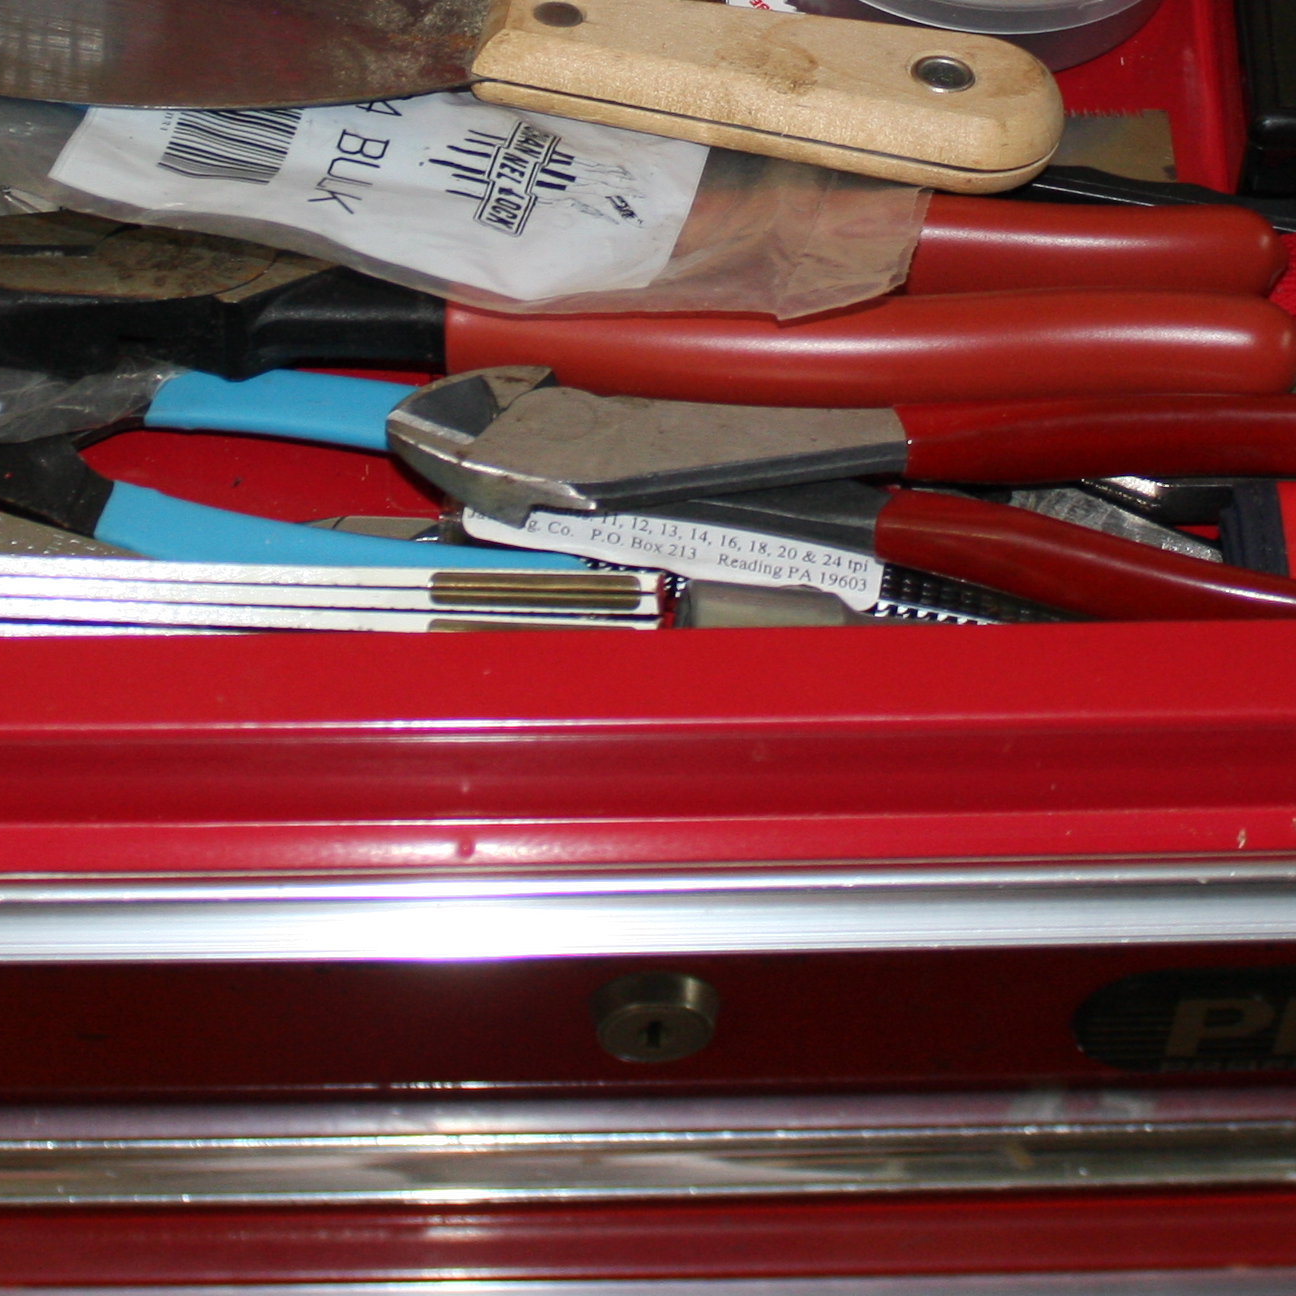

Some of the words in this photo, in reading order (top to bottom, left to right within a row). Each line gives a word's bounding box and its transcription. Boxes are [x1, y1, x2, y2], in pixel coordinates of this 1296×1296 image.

[307, 129, 391, 215] BULK
[548, 521, 574, 537] Co.
[590, 529, 624, 547] P.O.
[630, 536, 664, 554] Box
[667, 544, 697, 560] 213
[717, 553, 783, 579] Reading
[788, 567, 812, 583] PA
[820, 571, 868, 592] 19603
[632, 515, 653, 535] 12,
[661, 522, 683, 541] 13,
[691, 527, 713, 545] 14,
[721, 534, 742, 552] 16,
[750, 539, 771, 557] 18,
[777, 545, 797, 560] 20
[802, 550, 816, 564] &
[824, 554, 842, 568] 24
[848, 558, 870, 573] tpi
